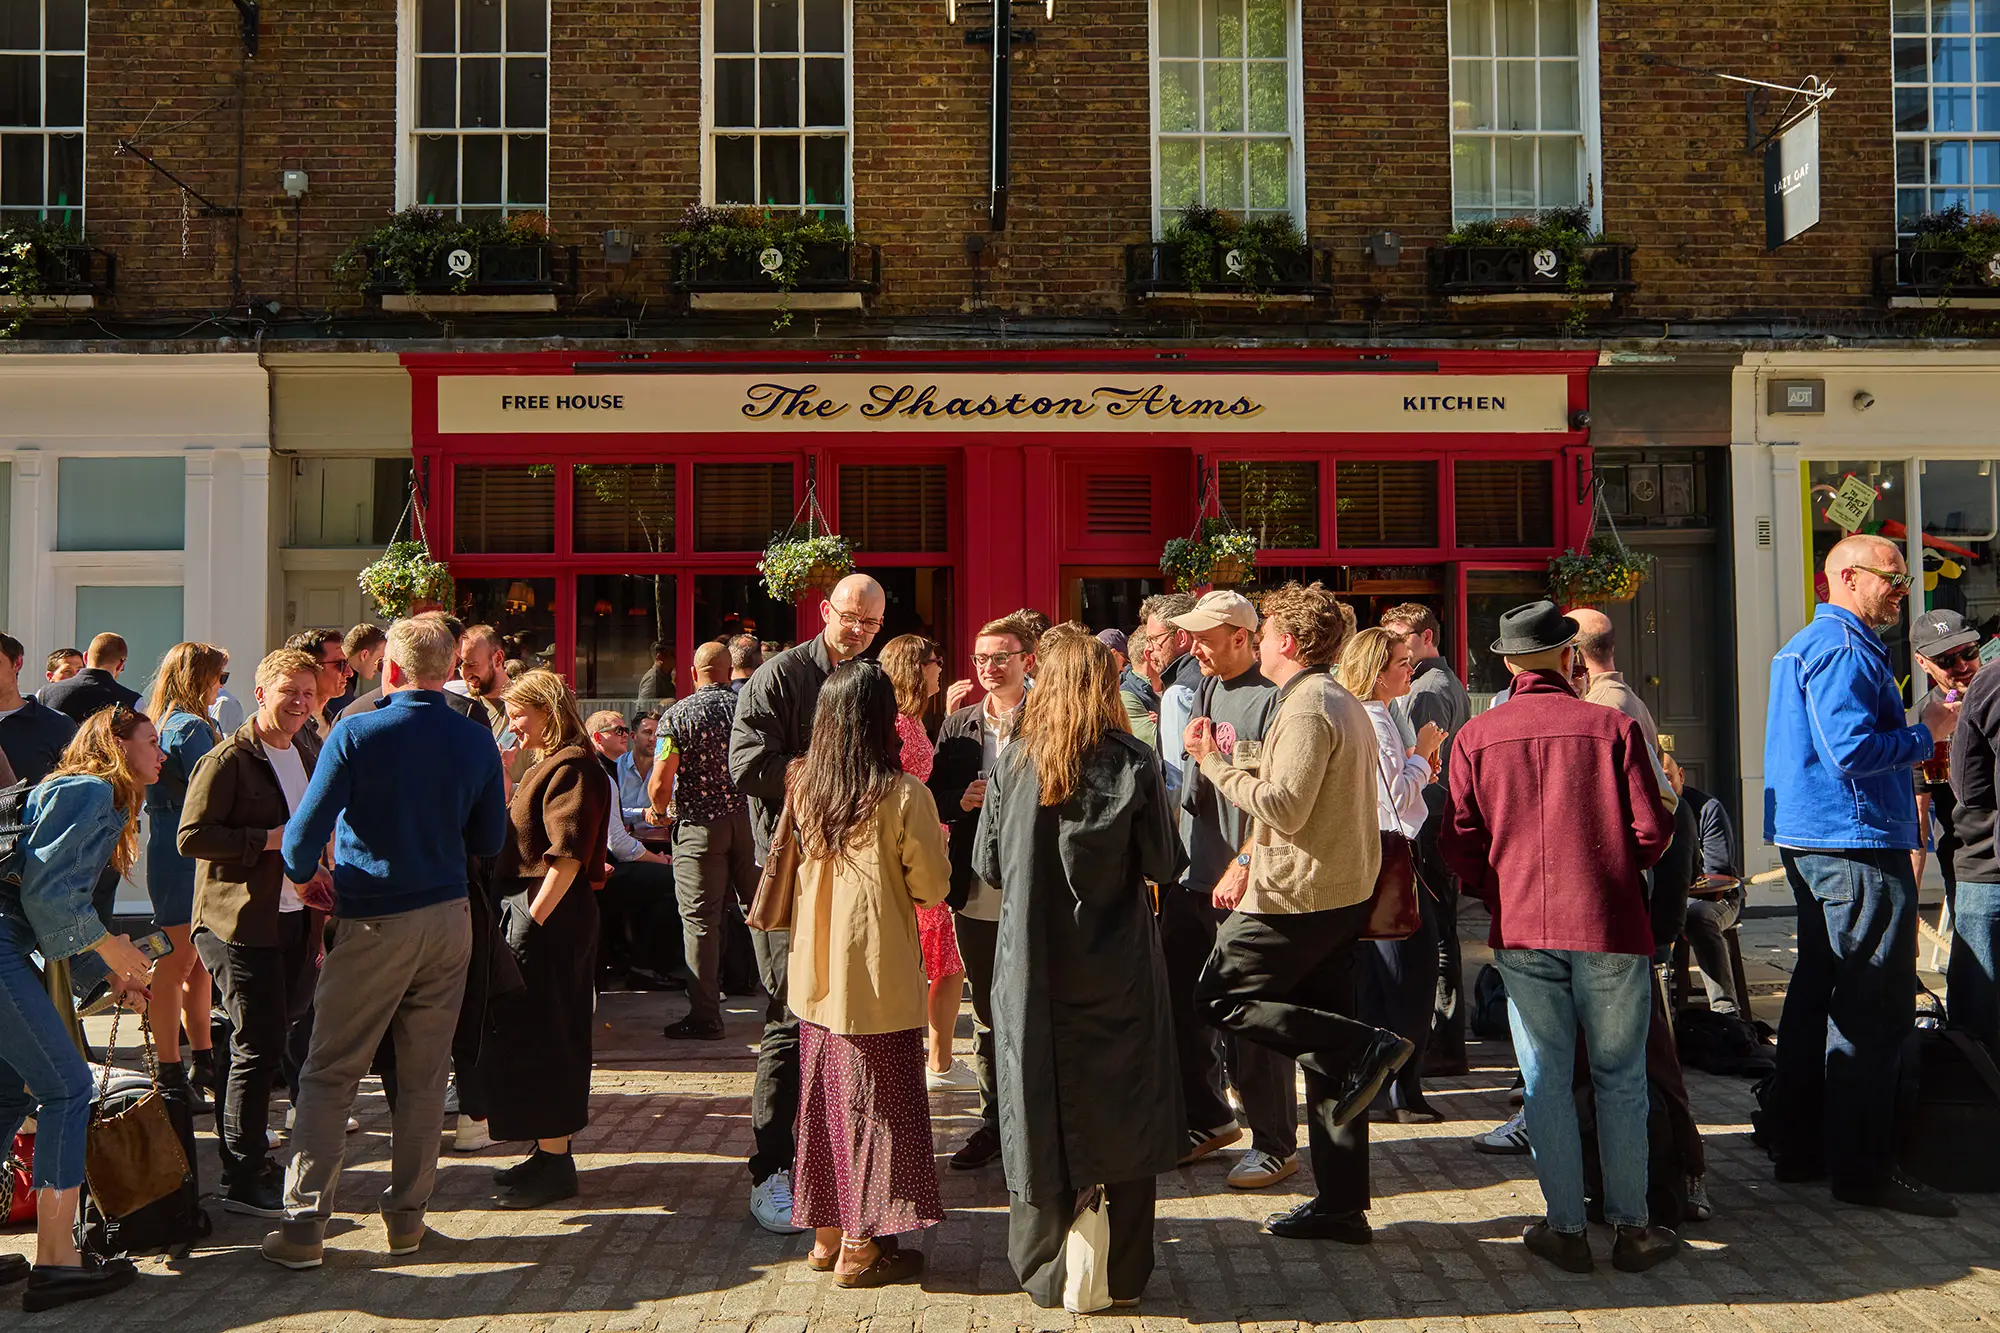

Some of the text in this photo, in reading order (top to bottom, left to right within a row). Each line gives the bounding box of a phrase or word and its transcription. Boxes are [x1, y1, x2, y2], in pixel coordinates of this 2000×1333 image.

[1774, 174, 1791, 194] LAZY
[502, 394, 624, 410] FREE HOUSE
[741, 383, 1264, 419] The Shaston Arms
[1403, 396, 1506, 411] KITCHEN
[1788, 391, 1812, 403] ADT
